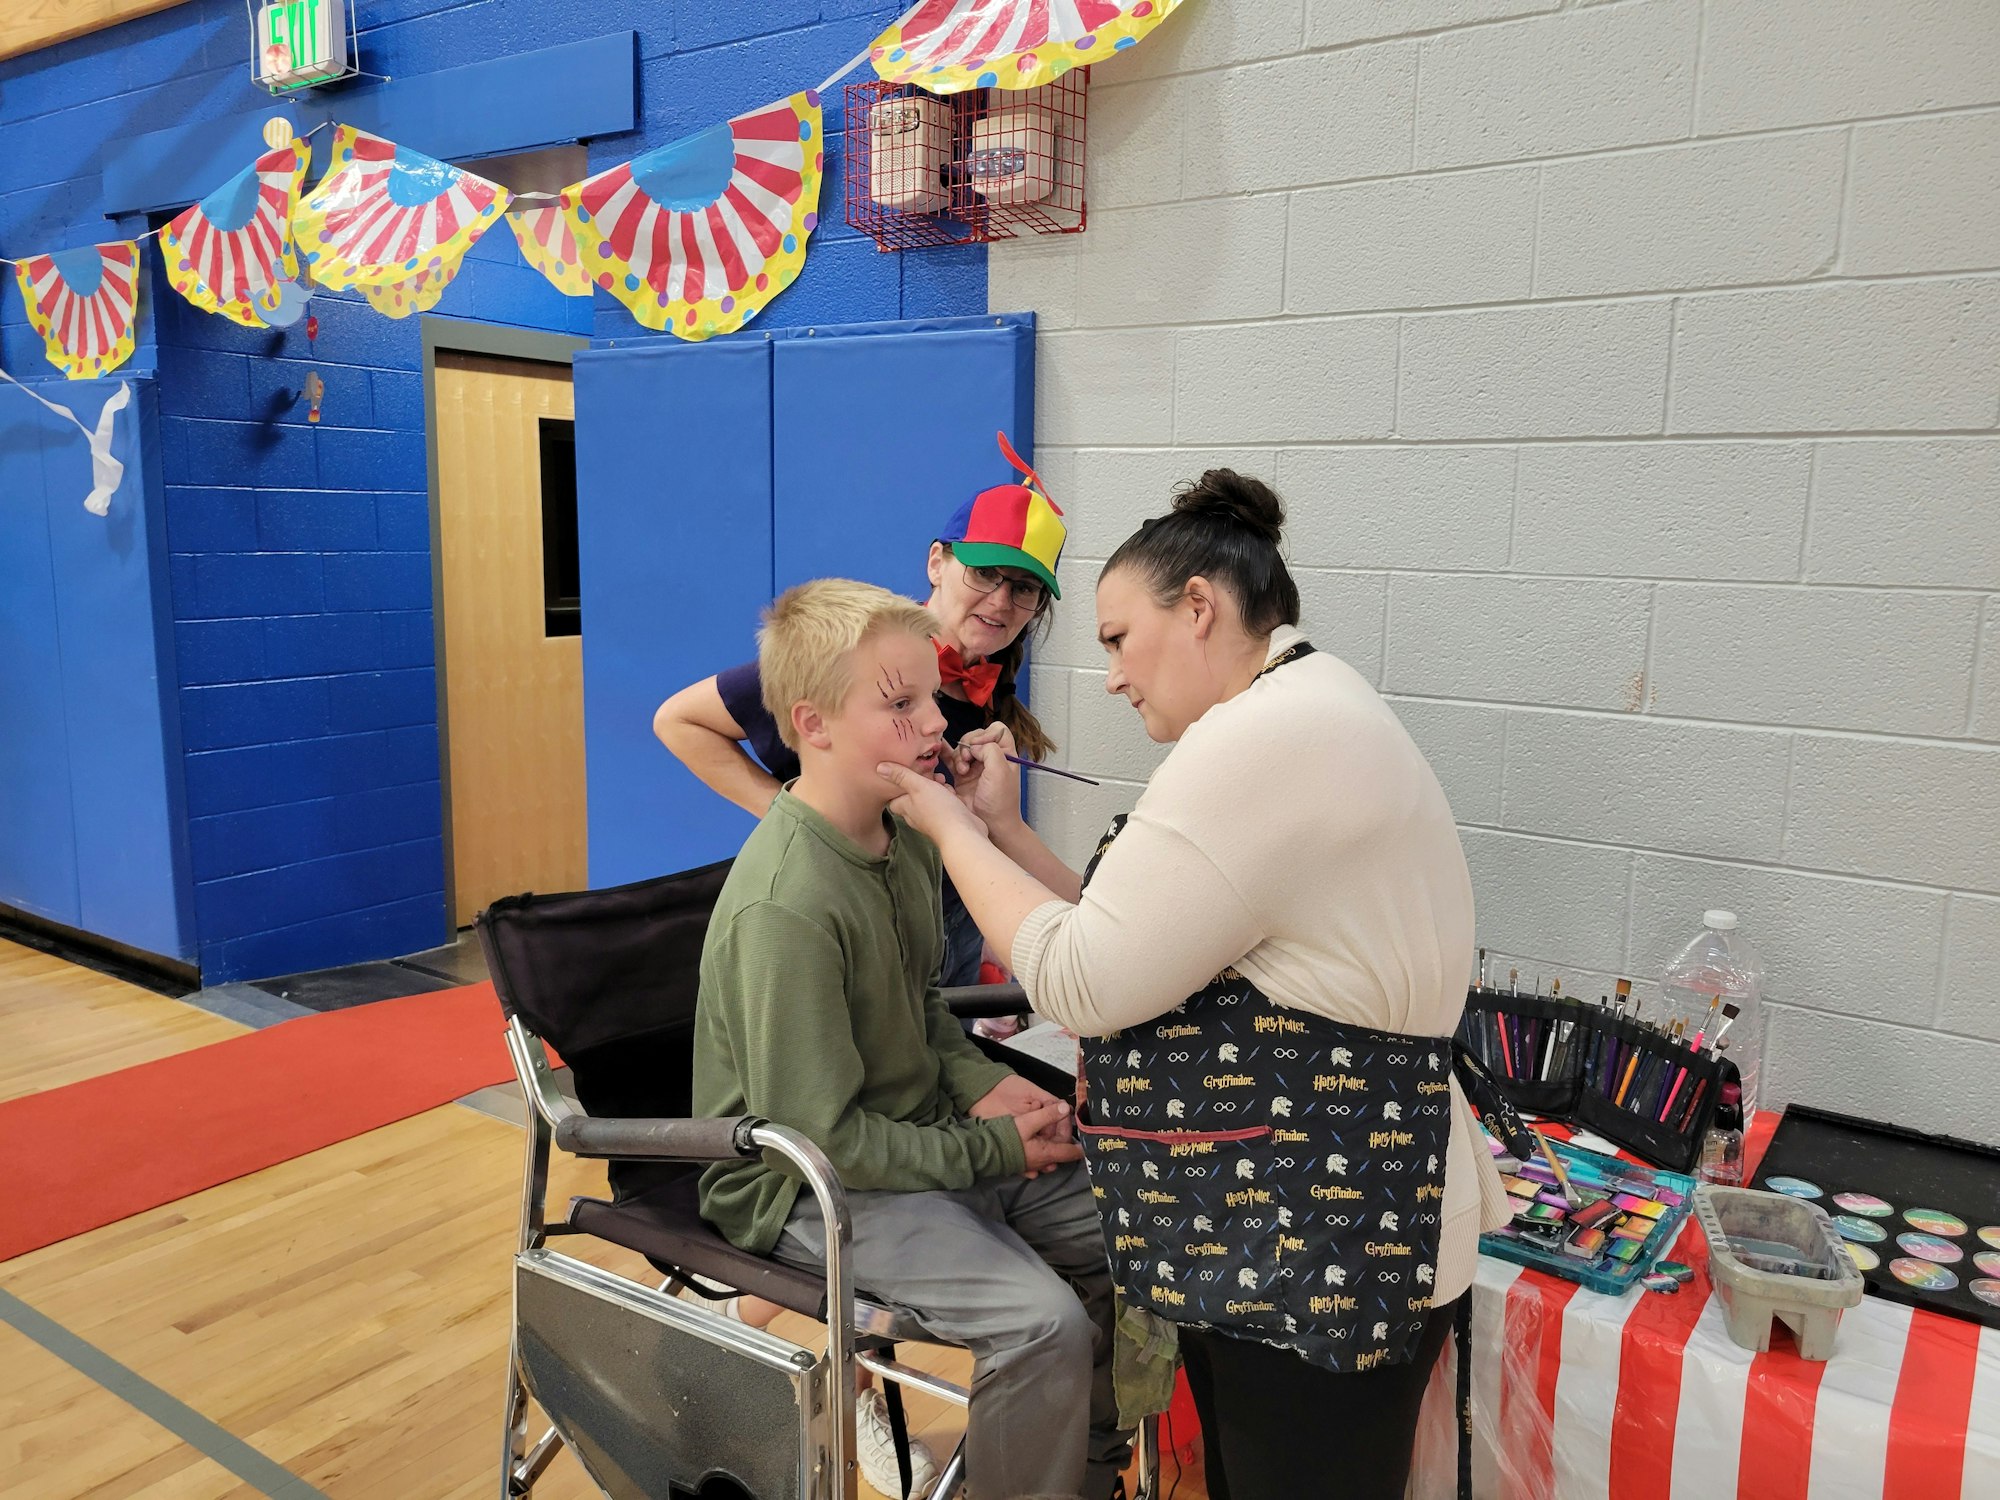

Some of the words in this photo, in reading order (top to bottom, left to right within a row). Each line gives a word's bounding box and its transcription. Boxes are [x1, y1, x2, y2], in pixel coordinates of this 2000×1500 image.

[1156, 1024, 1201, 1040] Gryffindor
[1254, 1015, 1279, 1034] Harry
[1278, 1015, 1305, 1038] Potter
[1116, 1076, 1132, 1094] Harry
[1131, 1075, 1151, 1097] Potter
[1203, 1073, 1254, 1090] Gryffindor
[1313, 1074, 1339, 1092] Harry
[1339, 1073, 1366, 1096] Potter
[1274, 1128, 1307, 1142] ffindor
[1369, 1130, 1392, 1149] Harry
[1391, 1129, 1413, 1152] Potter
[1190, 1141, 1214, 1158] Potter
[1136, 1188, 1177, 1204] Gryffindor
[1225, 1192, 1248, 1208] Harry
[1247, 1187, 1271, 1209] Potter
[1310, 1184, 1362, 1200] Gryffindor
[1185, 1242, 1228, 1256] Gryffindor
[1278, 1233, 1304, 1255] Potter
[1364, 1241, 1412, 1257] Gryffindor
[1163, 1287, 1186, 1308] Potter
[1309, 1296, 1334, 1315] Harry
[1333, 1294, 1356, 1318] Potter
[1226, 1300, 1275, 1315] Gryffindor
